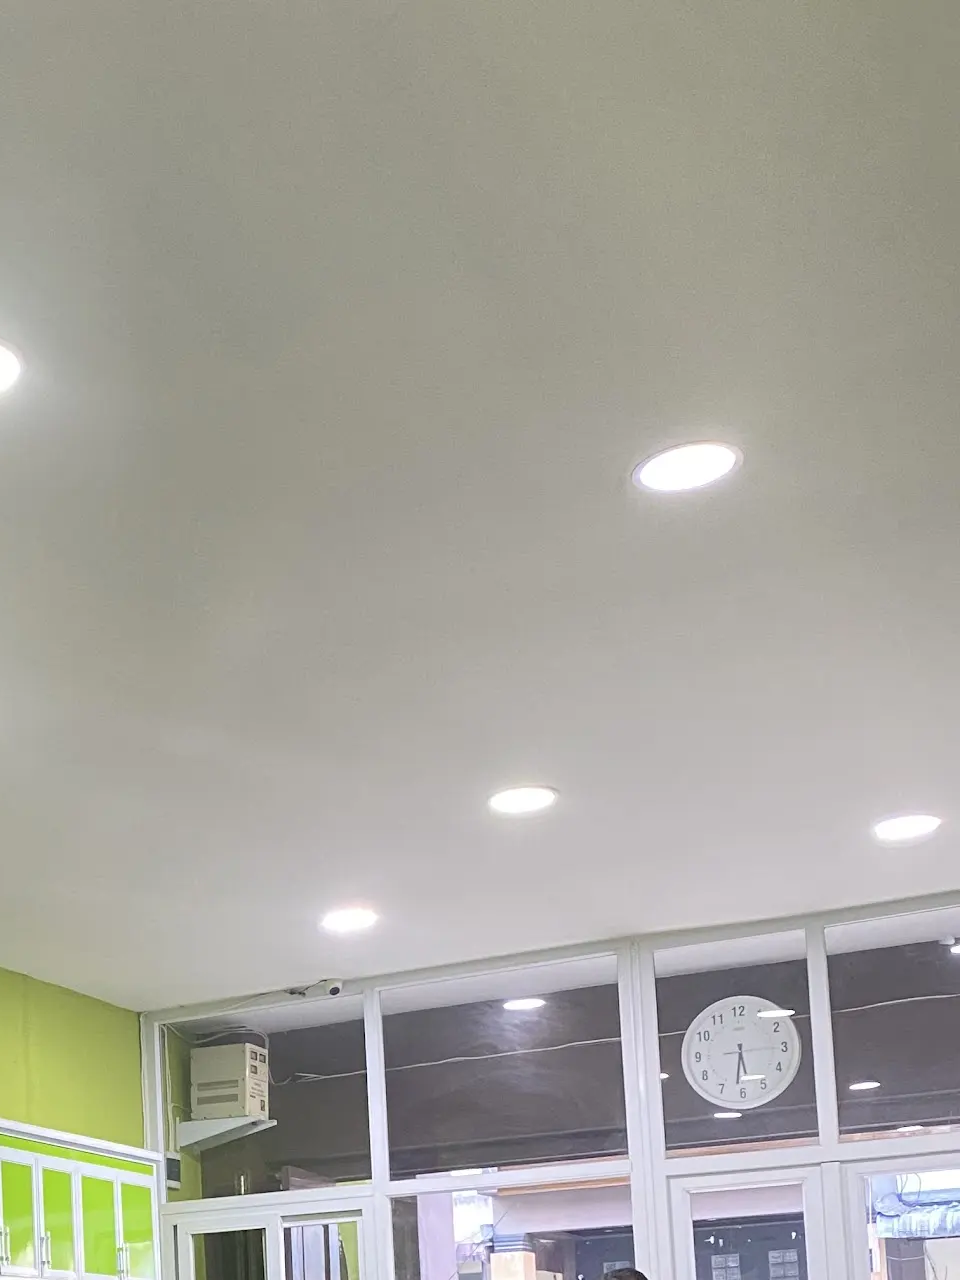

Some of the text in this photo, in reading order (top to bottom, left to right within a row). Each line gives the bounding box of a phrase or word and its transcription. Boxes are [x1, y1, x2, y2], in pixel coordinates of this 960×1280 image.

[731, 1005, 745, 1017] 12
[711, 1014, 723, 1026] 11
[773, 1021, 780, 1033] 2
[696, 1030, 710, 1042] 10
[780, 1041, 788, 1053] 3
[695, 1051, 702, 1063] 9
[775, 1061, 782, 1073] 4
[702, 1069, 708, 1081] 8
[718, 1083, 725, 1094] 7
[760, 1079, 767, 1090] 5
[740, 1087, 746, 1099] 6
